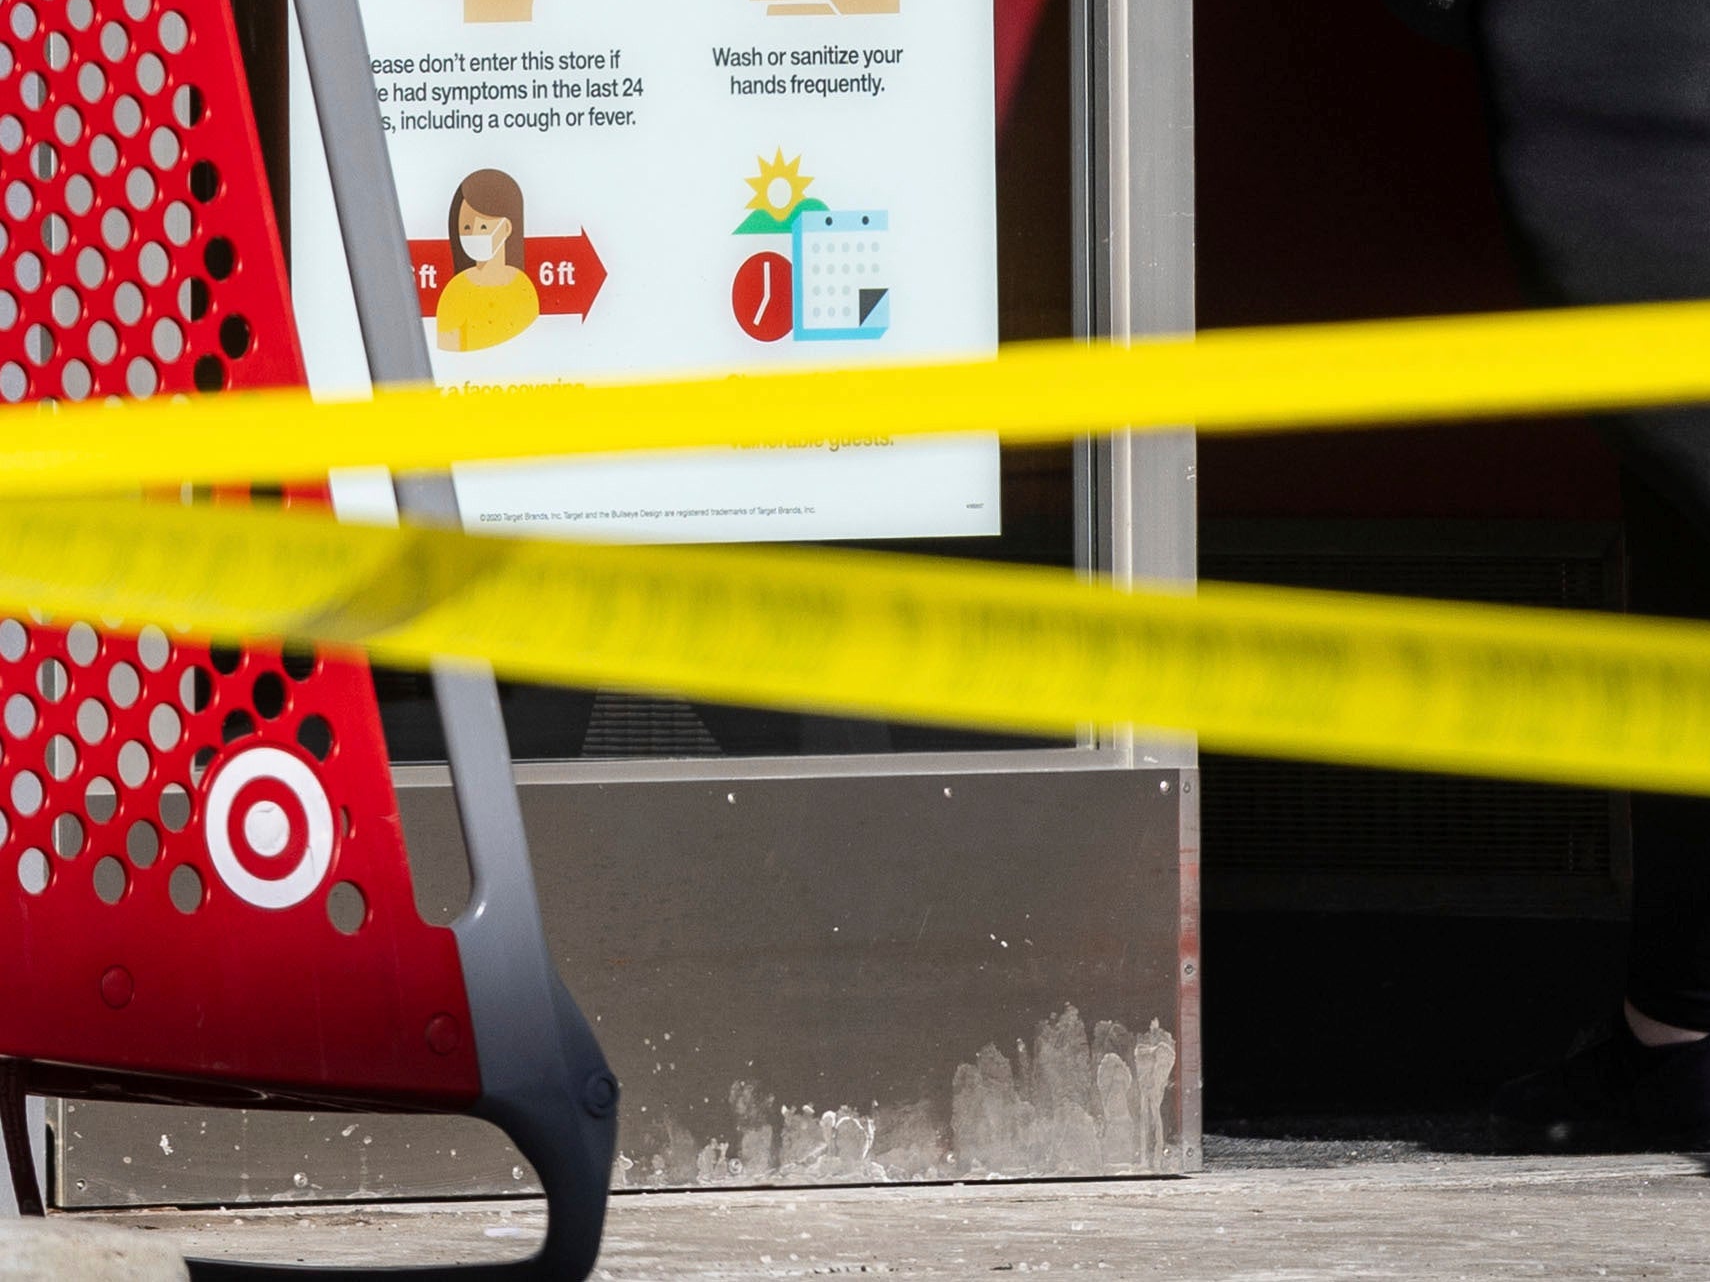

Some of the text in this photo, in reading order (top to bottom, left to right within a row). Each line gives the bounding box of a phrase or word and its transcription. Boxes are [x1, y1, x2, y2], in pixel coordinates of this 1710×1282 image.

[371, 49, 621, 74] ease don't enter this store if
[712, 46, 903, 70] Wash or sanitize your
[393, 82, 427, 102] had
[431, 81, 528, 105] symptoms
[532, 79, 548, 99] in
[552, 79, 582, 98] the
[586, 78, 619, 98] last
[622, 77, 644, 97] 24
[729, 72, 886, 98] hands frequently.
[400, 110, 483, 133] including
[487, 114, 500, 129] a
[503, 108, 561, 132] cough
[565, 111, 584, 127] or
[588, 107, 636, 126] fever.
[418, 264, 437, 289] ft
[539, 261, 575, 286] 6 ft
[504, 513, 523, 522] Target
[564, 511, 582, 520] Target
[585, 511, 597, 519] and
[611, 510, 638, 519] Bullseye
[640, 509, 662, 518] Design
[676, 508, 710, 517] registered
[711, 507, 747, 515] trademarks
[749, 507, 756, 515] of
[757, 507, 776, 516] Target
